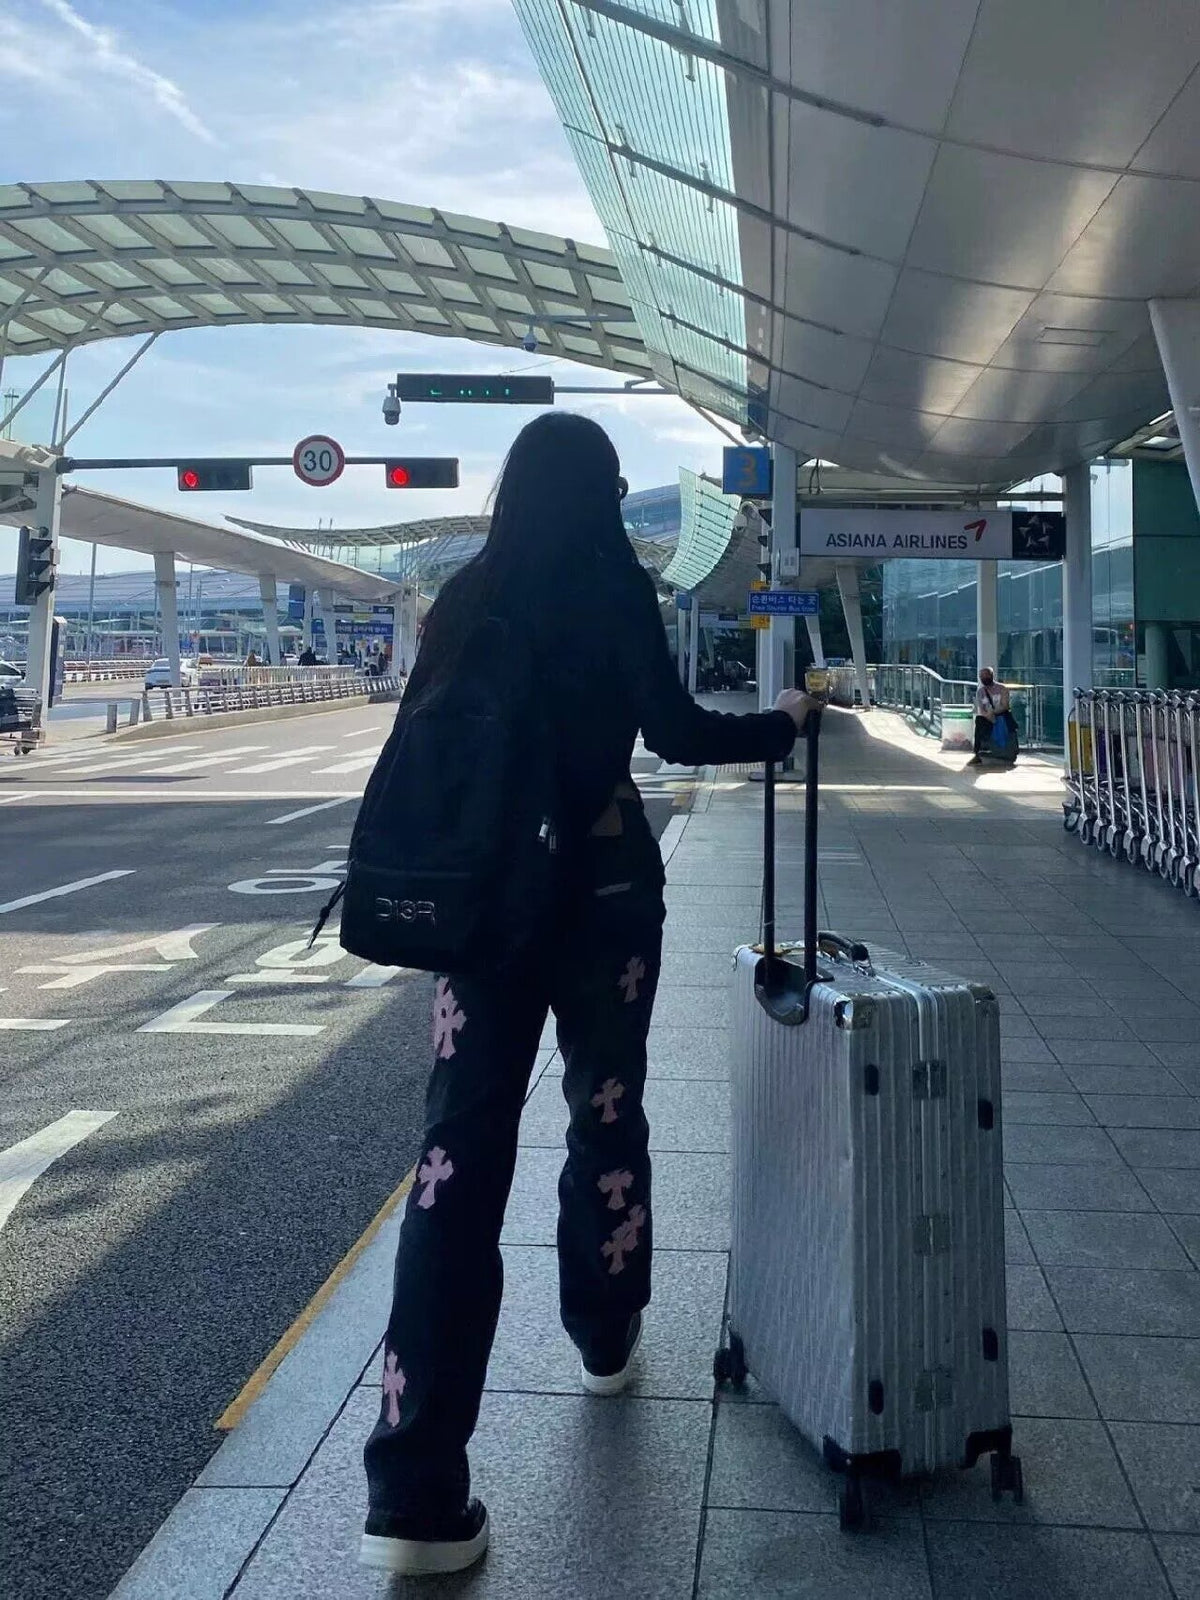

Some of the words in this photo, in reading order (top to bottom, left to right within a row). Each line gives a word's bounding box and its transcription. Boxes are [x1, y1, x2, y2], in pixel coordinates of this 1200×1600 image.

[303, 449, 332, 472] 30
[737, 452, 758, 488] 3
[826, 533, 887, 548] ASIANA
[893, 534, 968, 550] AIRLINES
[751, 595, 785, 604] 순환버스
[788, 595, 805, 605] 타는
[807, 596, 817, 605] 곳
[375, 897, 437, 926] DIOR
